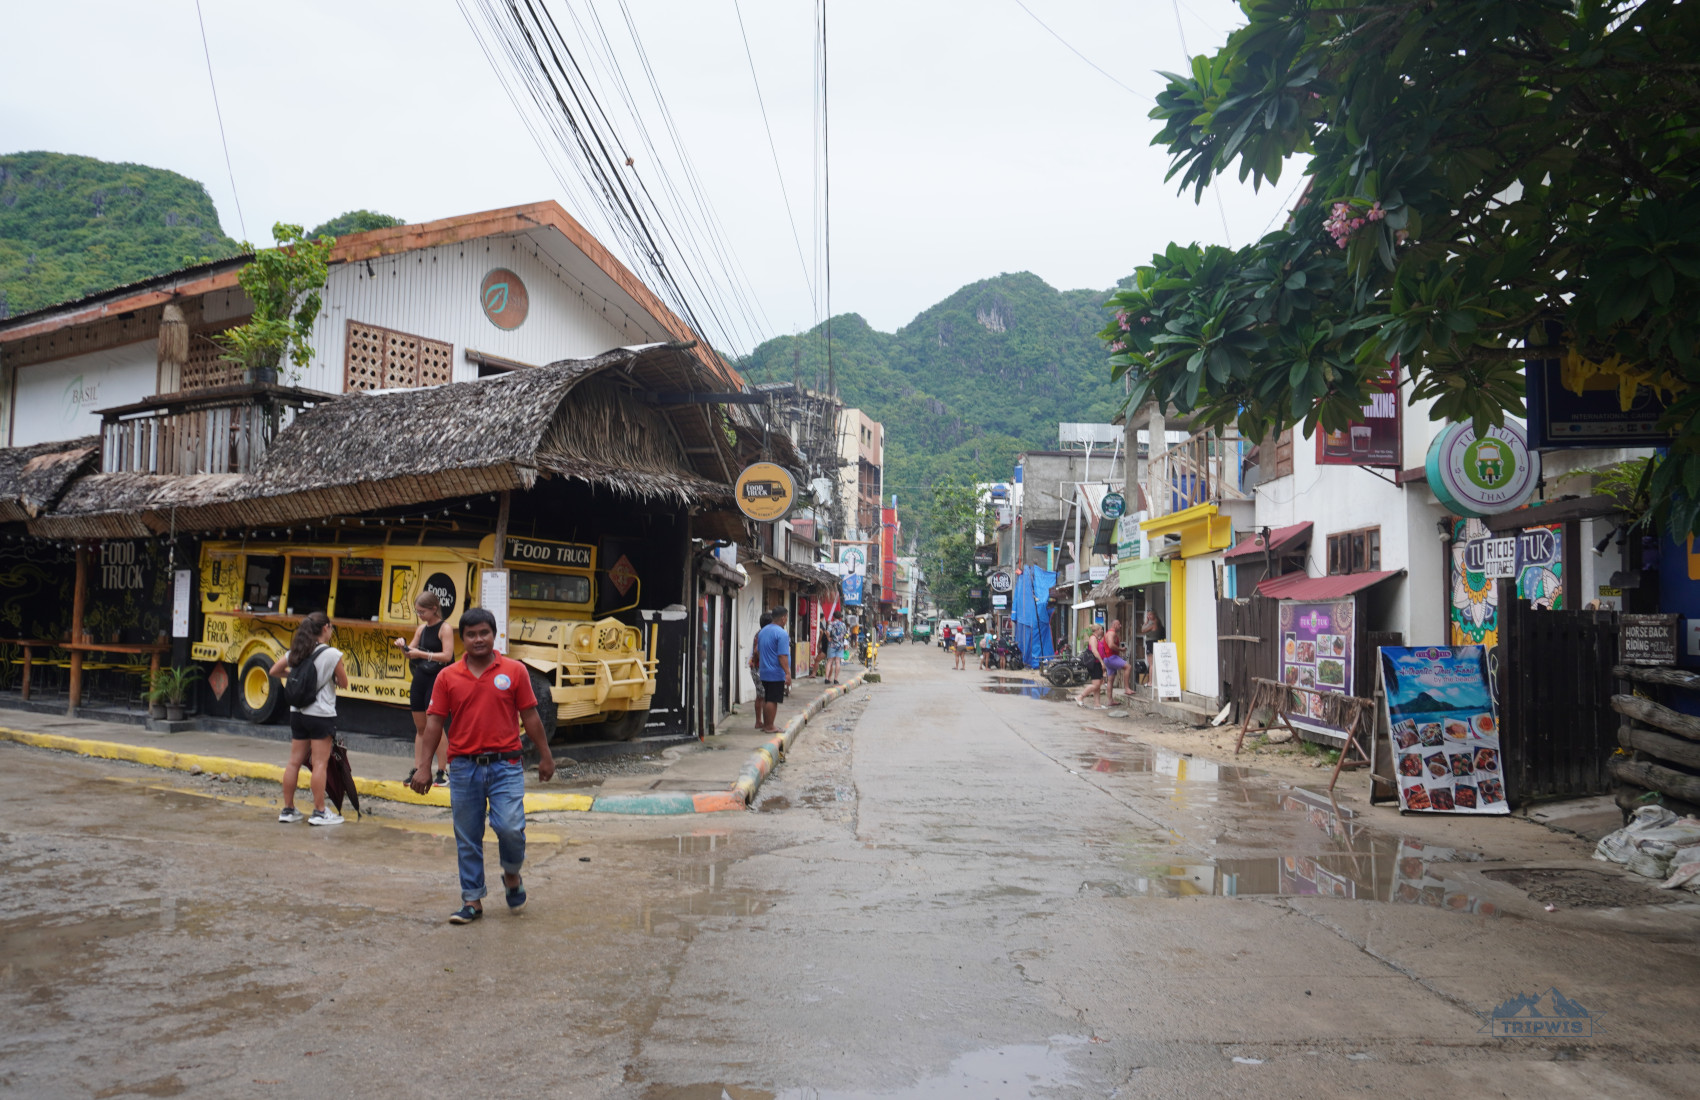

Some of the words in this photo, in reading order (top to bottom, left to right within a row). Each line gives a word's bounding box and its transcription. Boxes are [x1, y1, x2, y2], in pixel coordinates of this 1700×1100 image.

[72, 385, 97, 404] BASIL
[1491, 427, 1518, 449] TUK
[746, 483, 764, 491] FOOD
[747, 489, 768, 497] TRUCK
[1480, 490, 1506, 501] THAI
[100, 542, 135, 565] FOOD
[512, 543, 551, 560] FOOD
[556, 547, 590, 563] TRUCK
[1470, 543, 1485, 566] TU
[1520, 534, 1551, 562] TUK
[1487, 540, 1514, 559] RICOS
[101, 565, 144, 589] TRUCK
[206, 619, 228, 632] FOOD
[1625, 626, 1669, 638] HORSEBACK
[206, 631, 230, 644] TRUCK
[388, 663, 402, 673] WAY
[350, 683, 369, 694] WOK
[375, 686, 396, 696] WOK
